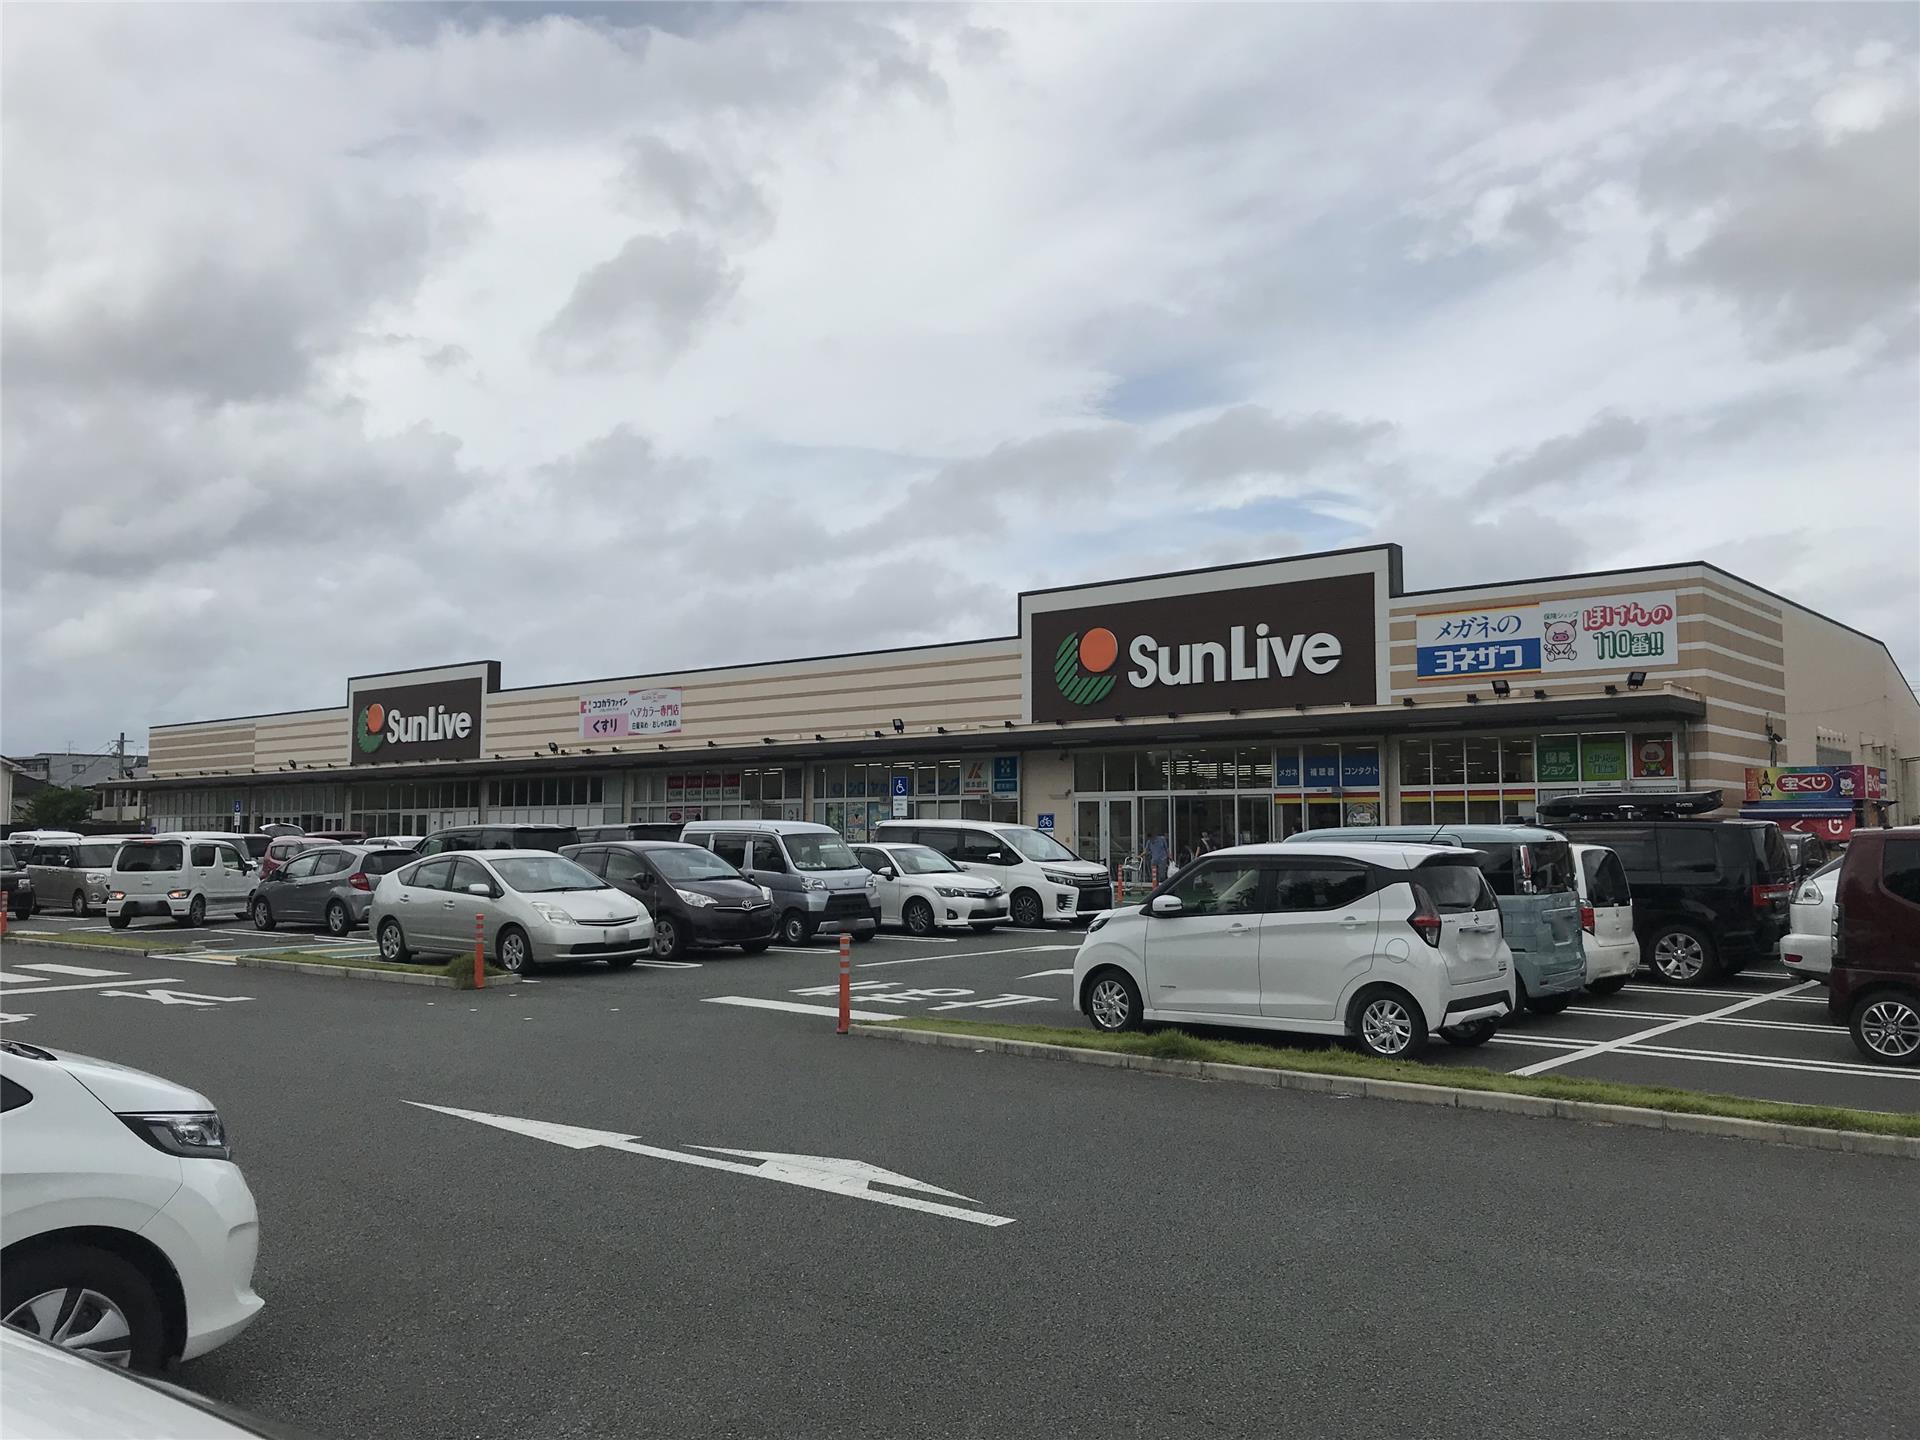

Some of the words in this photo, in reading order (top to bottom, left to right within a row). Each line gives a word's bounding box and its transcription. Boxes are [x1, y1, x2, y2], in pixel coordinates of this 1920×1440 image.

[1582, 602, 1673, 632] ほけんの
[1434, 614, 1522, 641] メガネの
[1127, 623, 1343, 689] SunLive
[1434, 644, 1523, 673] ヨネザワ
[593, 698, 628, 709] ココカラファイン
[630, 704, 680, 718] ヘアカラー専門店
[386, 705, 473, 744] SunLive
[592, 719, 618, 734] くすり
[1279, 768, 1299, 777] メガネ
[1344, 766, 1379, 776] コンタクト
[1541, 763, 1576, 776] ショップ
[1781, 776, 1827, 791] 宝くじ
